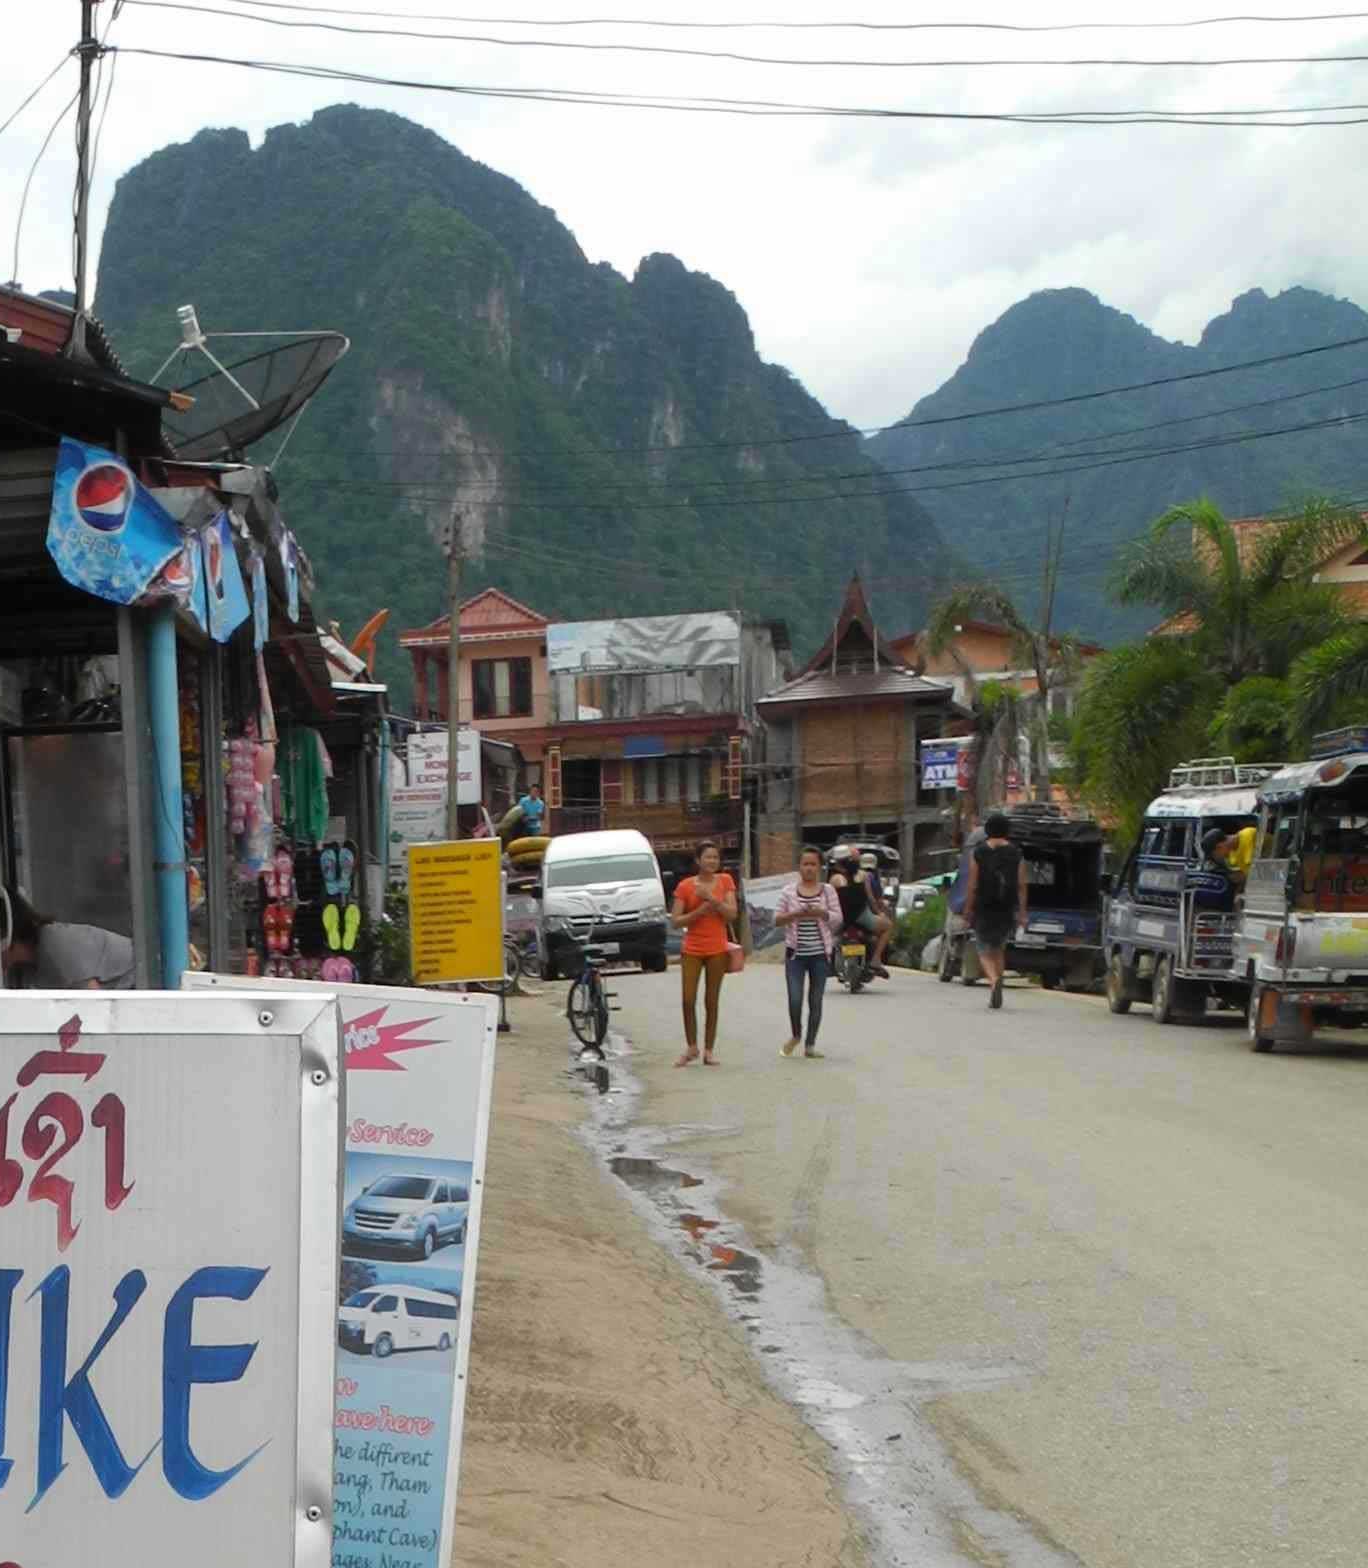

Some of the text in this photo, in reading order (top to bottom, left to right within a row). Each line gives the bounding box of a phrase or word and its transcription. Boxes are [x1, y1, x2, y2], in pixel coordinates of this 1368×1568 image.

[350, 1117, 434, 1147] Service
[377, 1404, 436, 1436] here
[380, 1471, 432, 1495] Tham
[370, 1498, 410, 1520] and
[388, 1527, 439, 1553] Cave)
